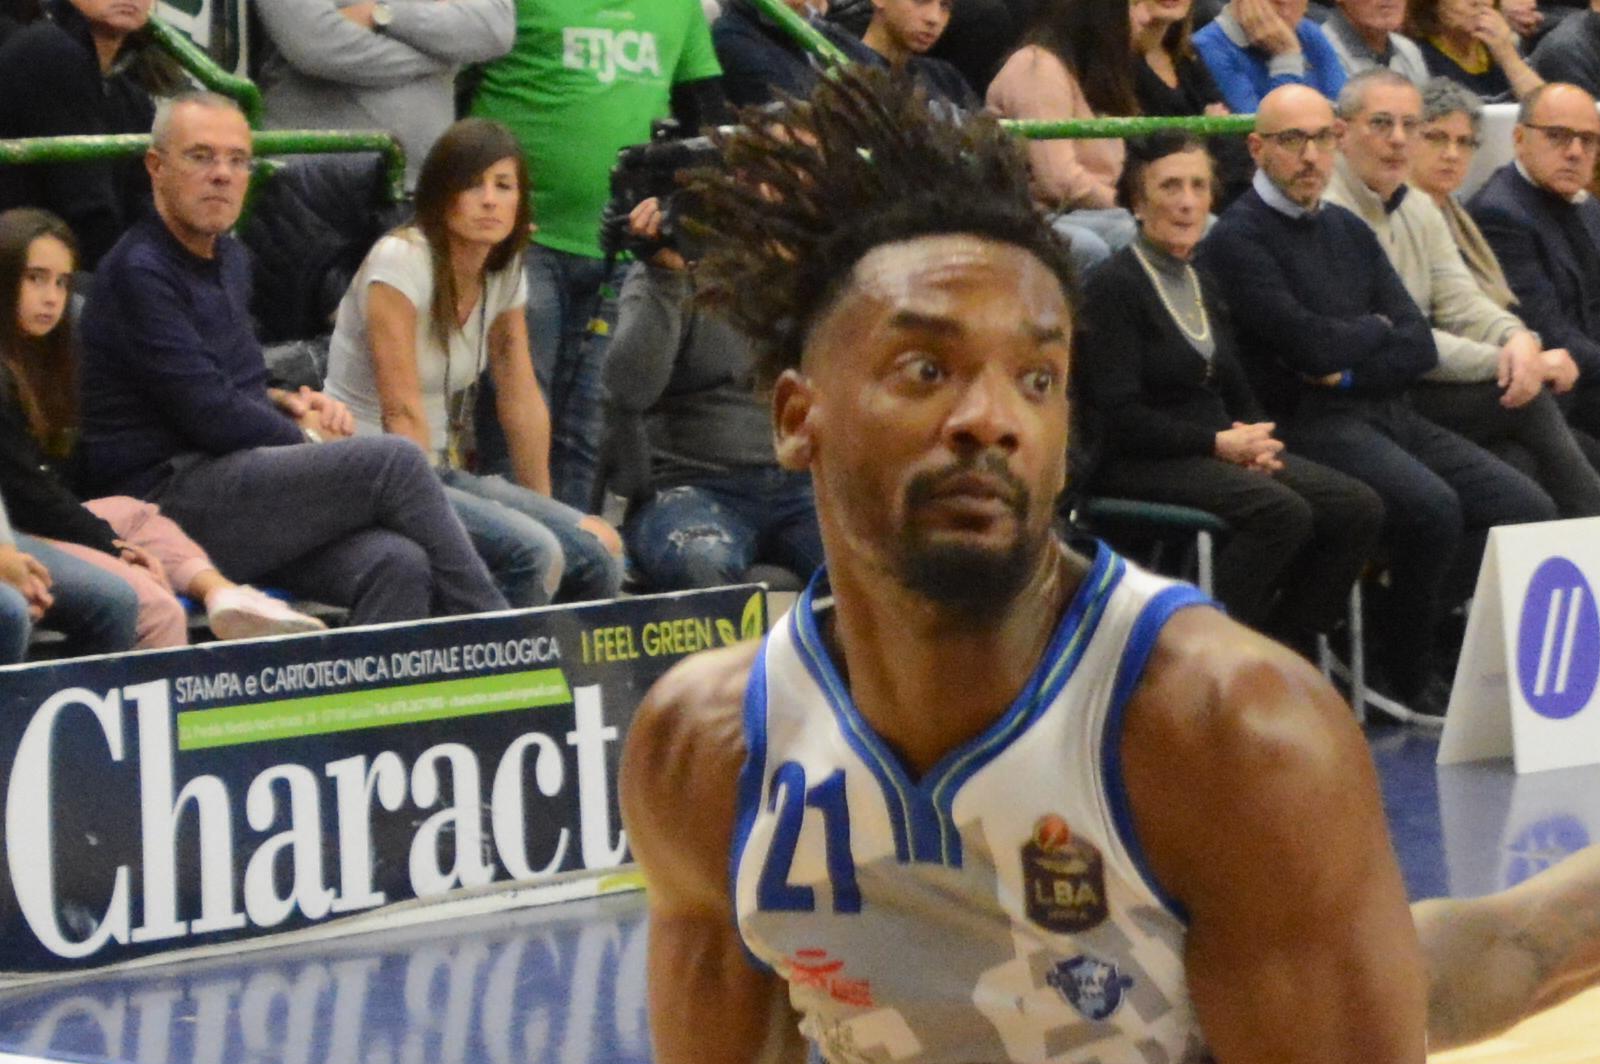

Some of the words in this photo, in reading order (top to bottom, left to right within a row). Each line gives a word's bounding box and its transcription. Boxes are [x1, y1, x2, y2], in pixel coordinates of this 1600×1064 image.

[175, 672, 242, 703] STAMPA
[245, 675, 257, 695] e
[260, 654, 389, 693] CARTOTECNICA
[391, 646, 460, 678] DIGITALE
[463, 636, 561, 671] ECOLOGICA
[581, 630, 589, 665] I
[593, 625, 640, 663] FEEL
[642, 617, 713, 657] GREEN
[5, 678, 628, 959] Charact
[756, 759, 863, 915] 21
[1034, 879, 1098, 907] LBA
